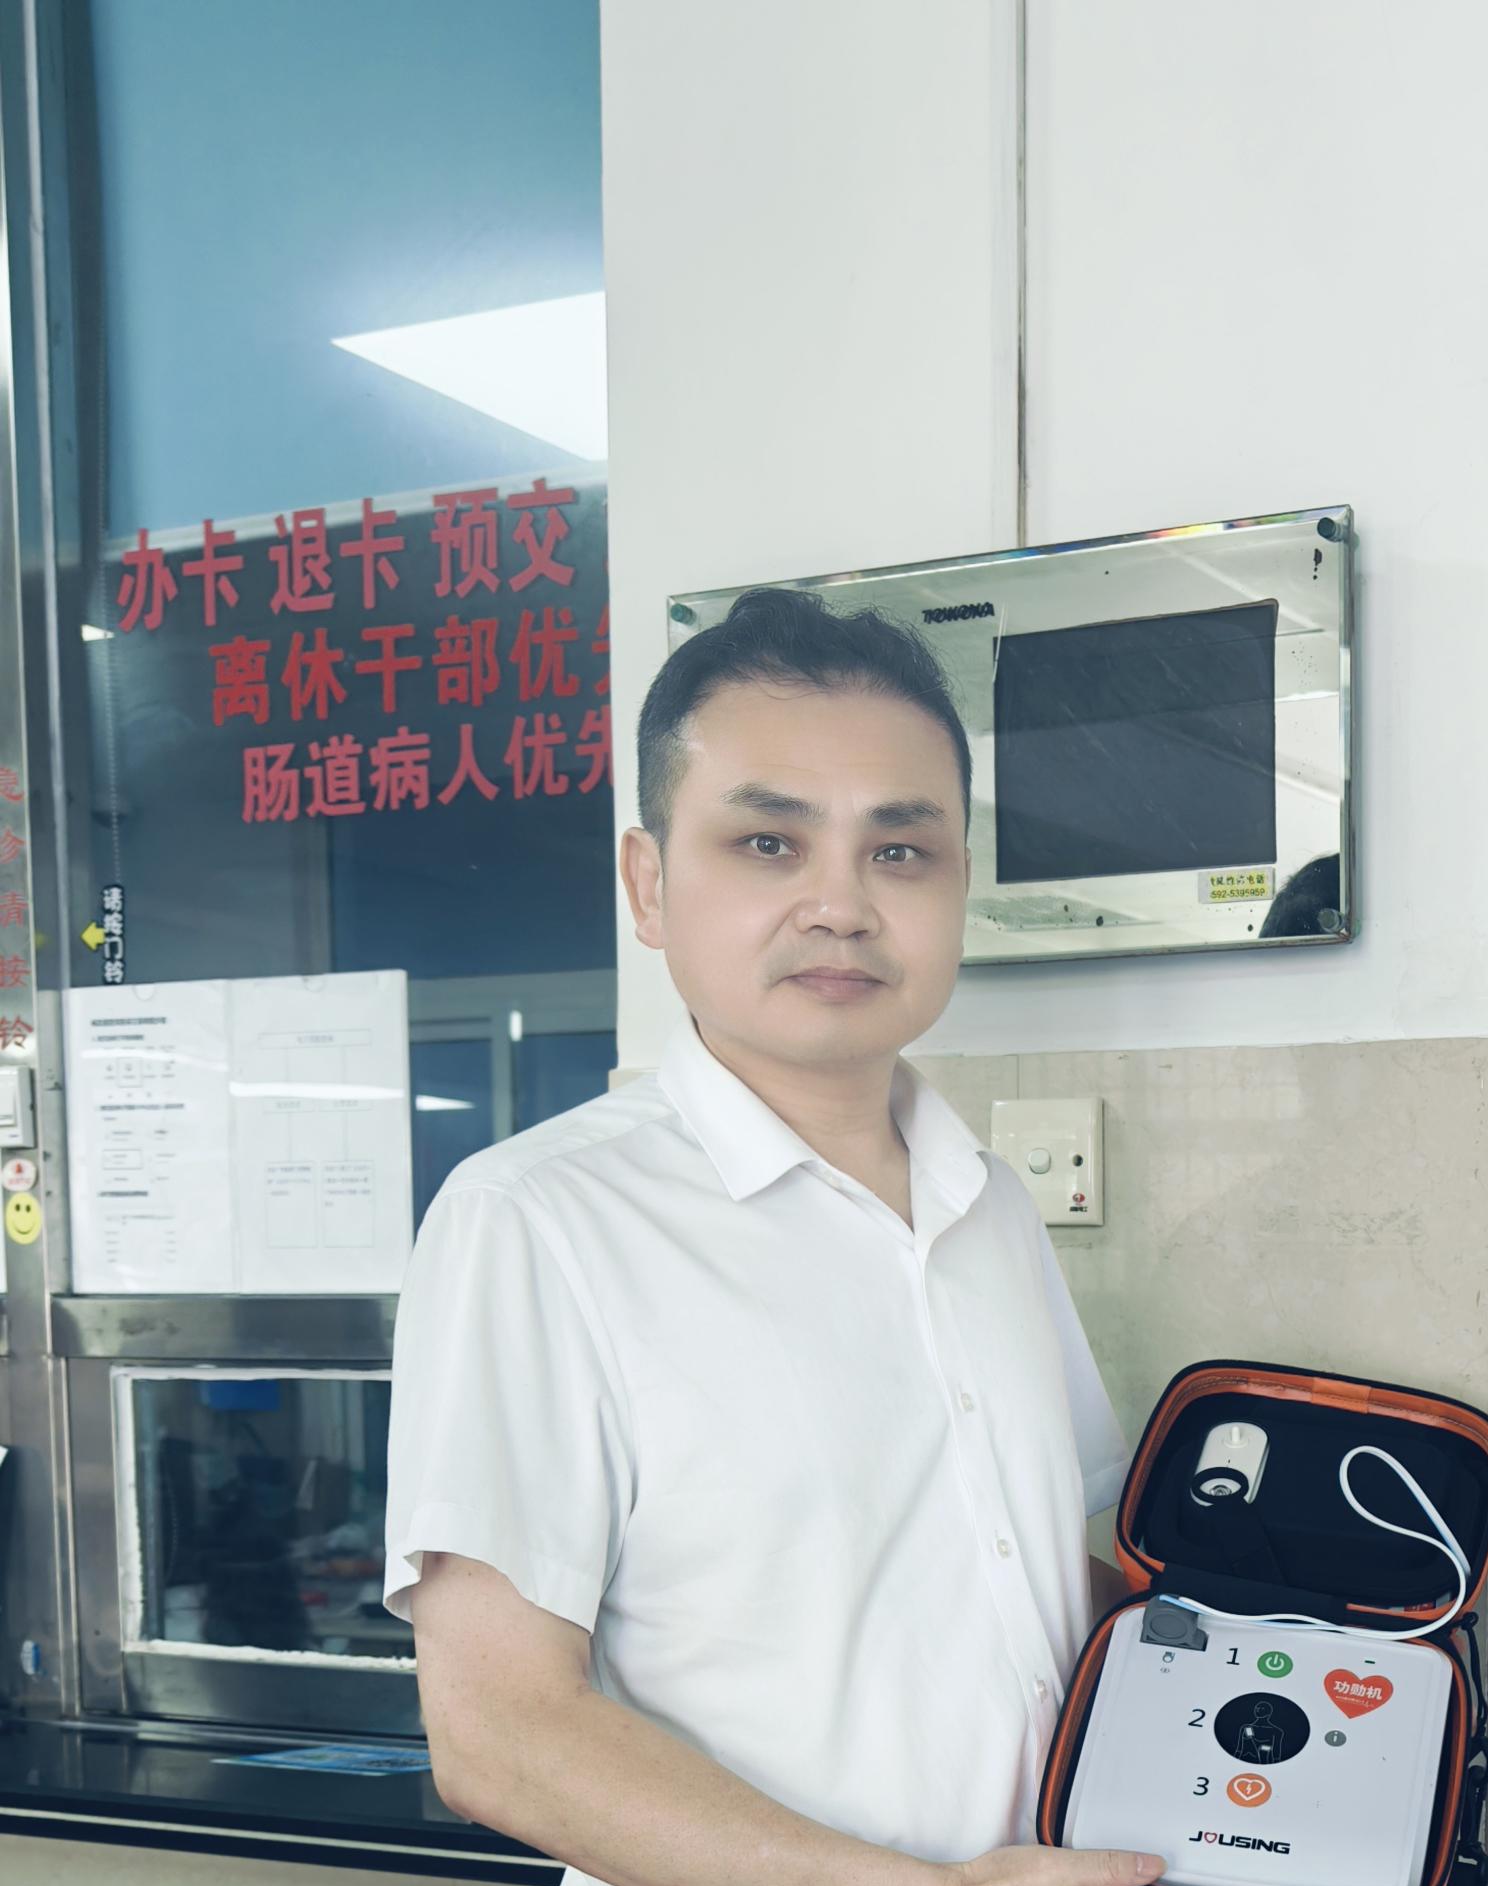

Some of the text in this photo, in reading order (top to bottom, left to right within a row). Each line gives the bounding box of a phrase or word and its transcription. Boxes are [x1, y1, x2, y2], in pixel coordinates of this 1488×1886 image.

[117, 478, 578, 633] 办卡 退卡 预交
[1225, 1647, 1240, 1666] 1
[1188, 1708, 1206, 1728] 2
[1193, 1776, 1210, 1796] 3
[1188, 1830, 1291, 1855] JOUSING
